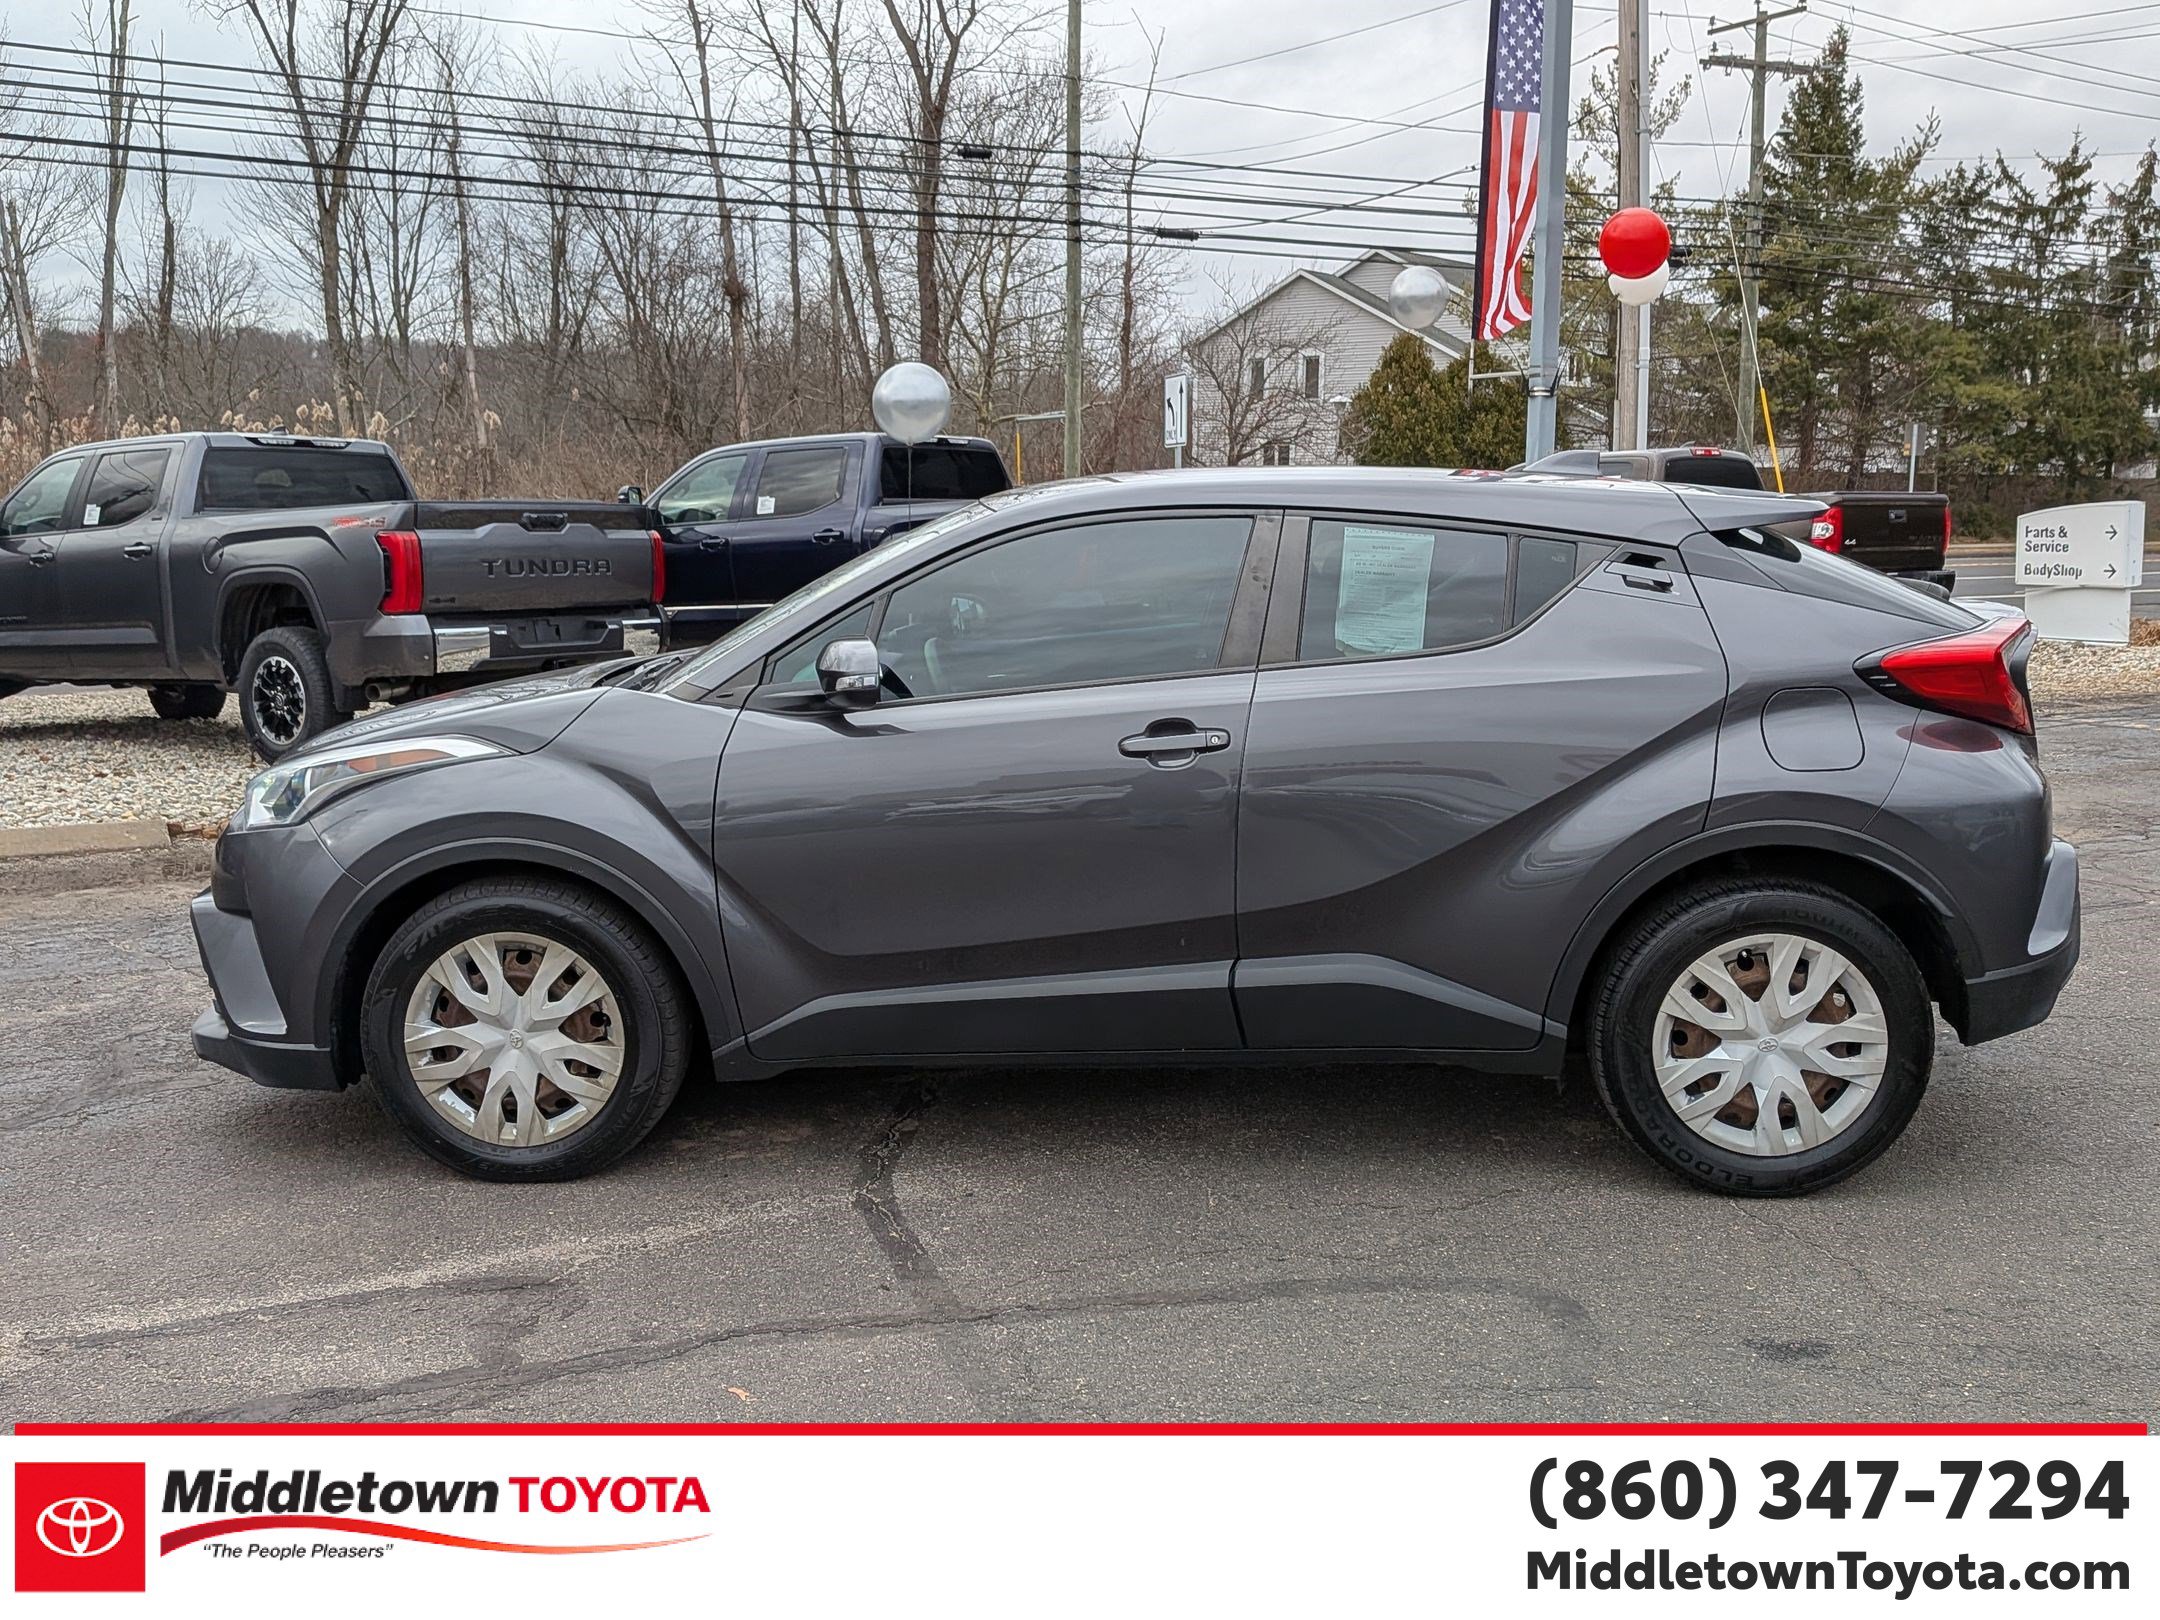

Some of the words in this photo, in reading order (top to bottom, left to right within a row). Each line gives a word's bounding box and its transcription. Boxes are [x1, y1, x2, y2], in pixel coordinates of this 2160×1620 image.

[2025, 525, 2055, 538] Parts
[2058, 525, 2068, 538] &
[2024, 540, 2069, 553] Service
[481, 559, 612, 578] TUNDRA
